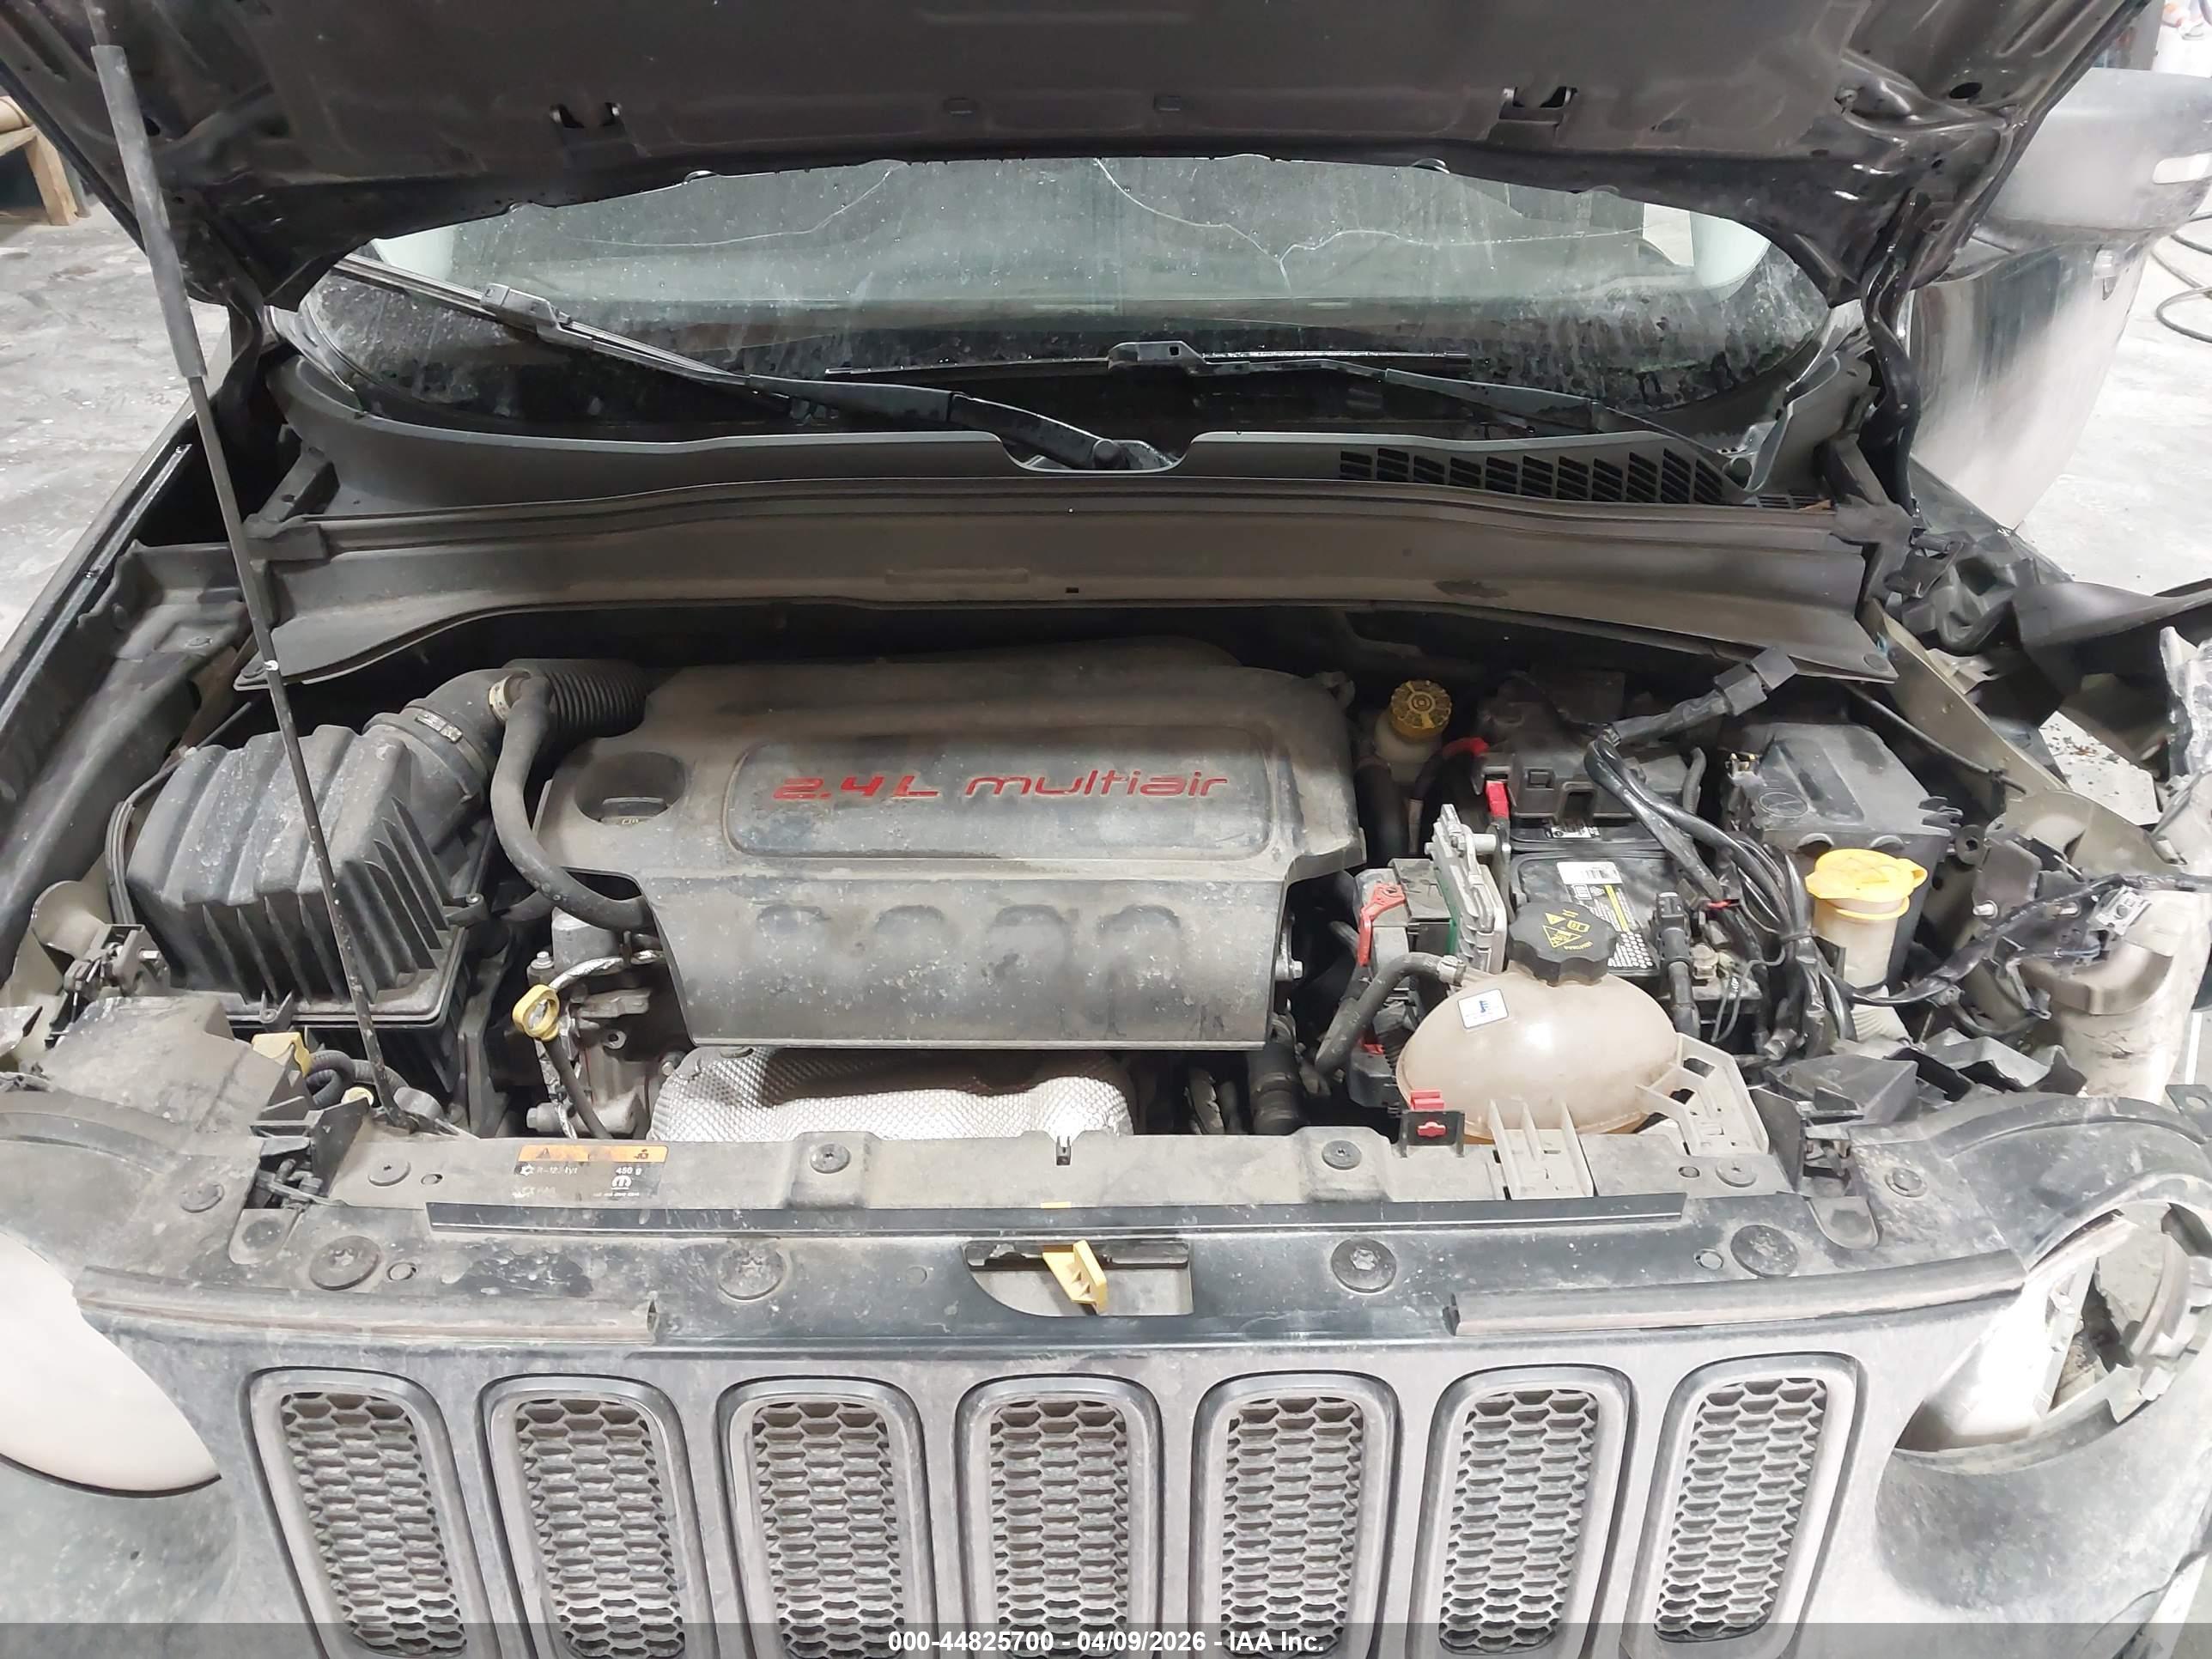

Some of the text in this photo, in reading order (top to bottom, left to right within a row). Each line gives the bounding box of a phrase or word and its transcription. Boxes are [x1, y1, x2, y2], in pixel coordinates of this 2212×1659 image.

[773, 769, 1227, 799] 2.4L multiair
[615, 1166, 634, 1175] 450
